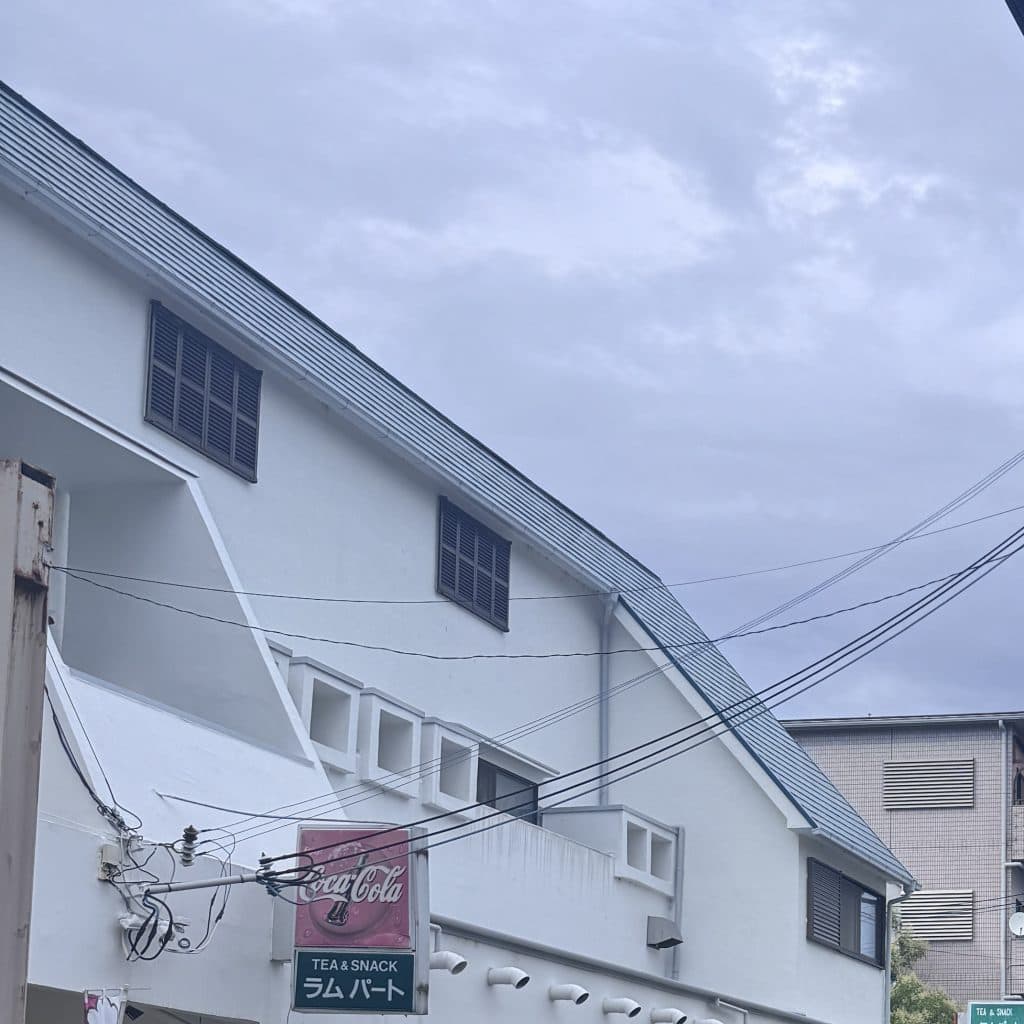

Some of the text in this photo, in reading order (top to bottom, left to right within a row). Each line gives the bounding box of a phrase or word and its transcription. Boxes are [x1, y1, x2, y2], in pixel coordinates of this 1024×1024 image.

[299, 864, 407, 904] Coca-Cola
[312, 959, 398, 972] TEA & SNACK
